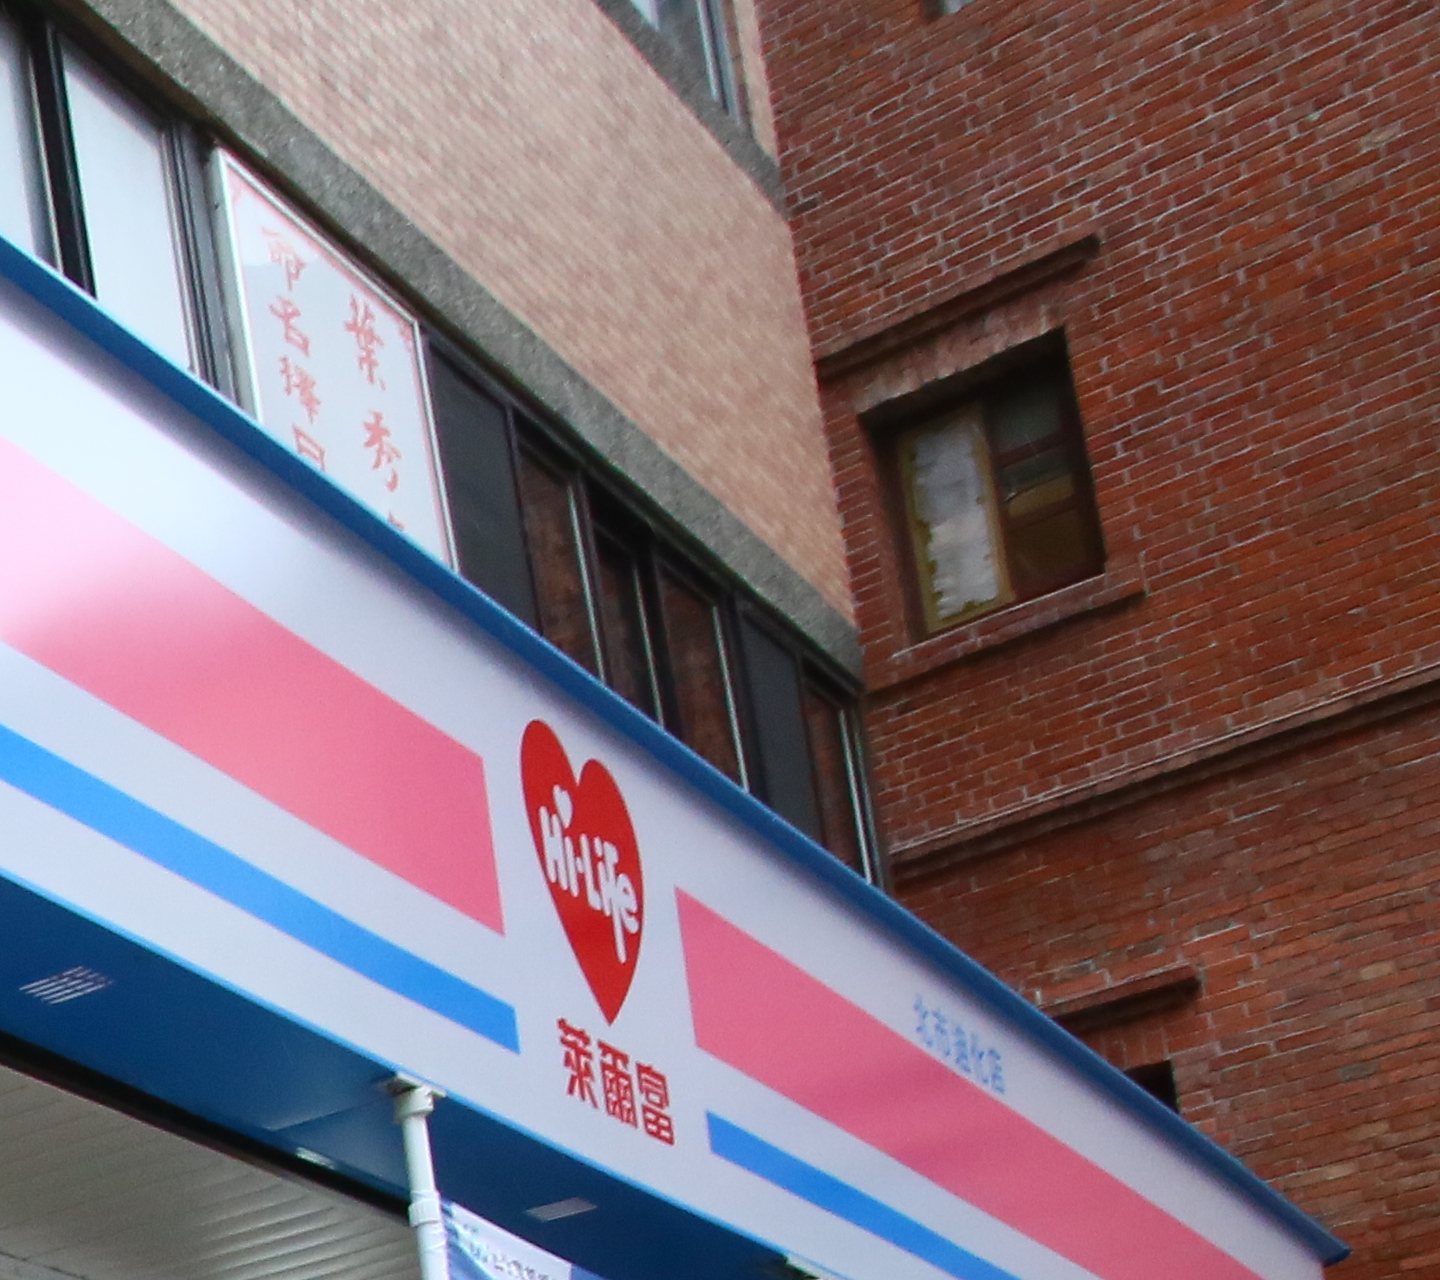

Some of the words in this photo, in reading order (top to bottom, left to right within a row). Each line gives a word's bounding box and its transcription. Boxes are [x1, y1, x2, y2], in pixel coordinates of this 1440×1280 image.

[345, 291, 404, 531] 葉秀
[557, 1016, 676, 1146] 萊爾富
